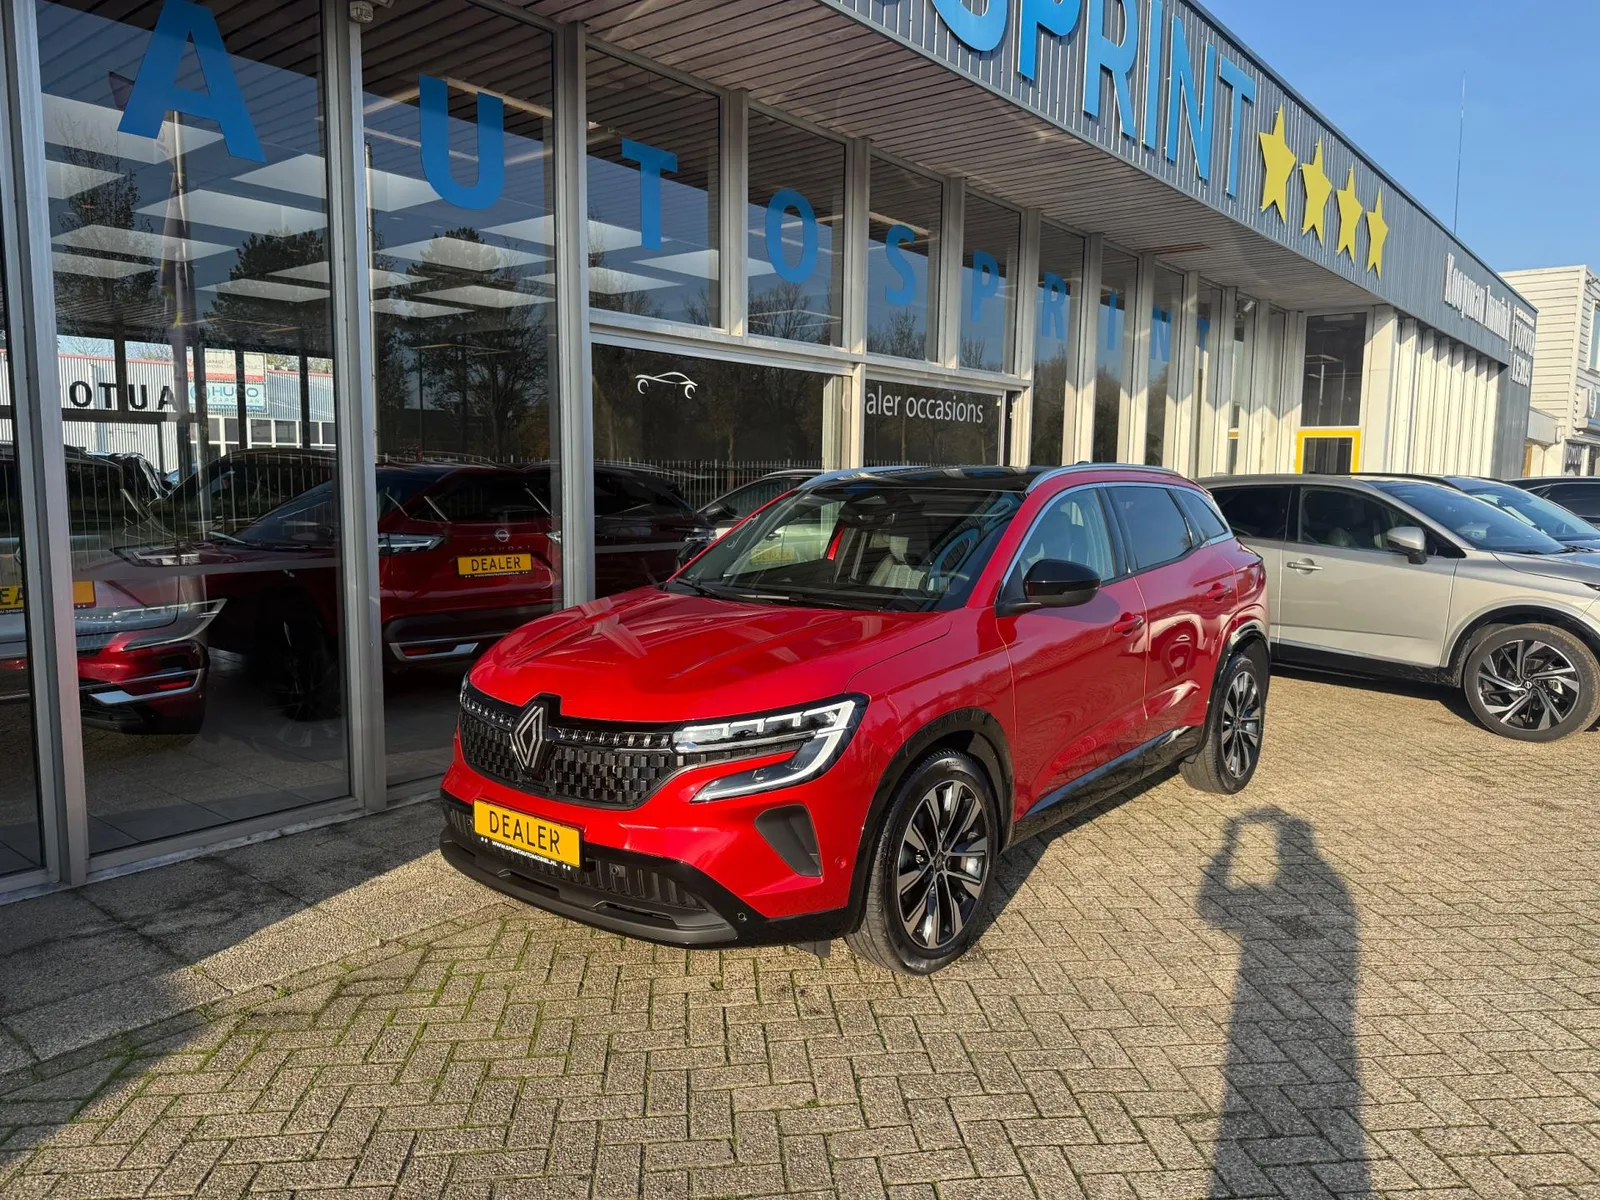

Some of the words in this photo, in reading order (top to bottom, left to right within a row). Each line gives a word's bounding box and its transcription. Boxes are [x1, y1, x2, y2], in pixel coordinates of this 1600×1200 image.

[212, 386, 259, 398] HUO
[865, 385, 901, 416] aler
[905, 395, 984, 424] occasions
[471, 557, 521, 571] DEALER
[490, 811, 560, 854] DEALER
